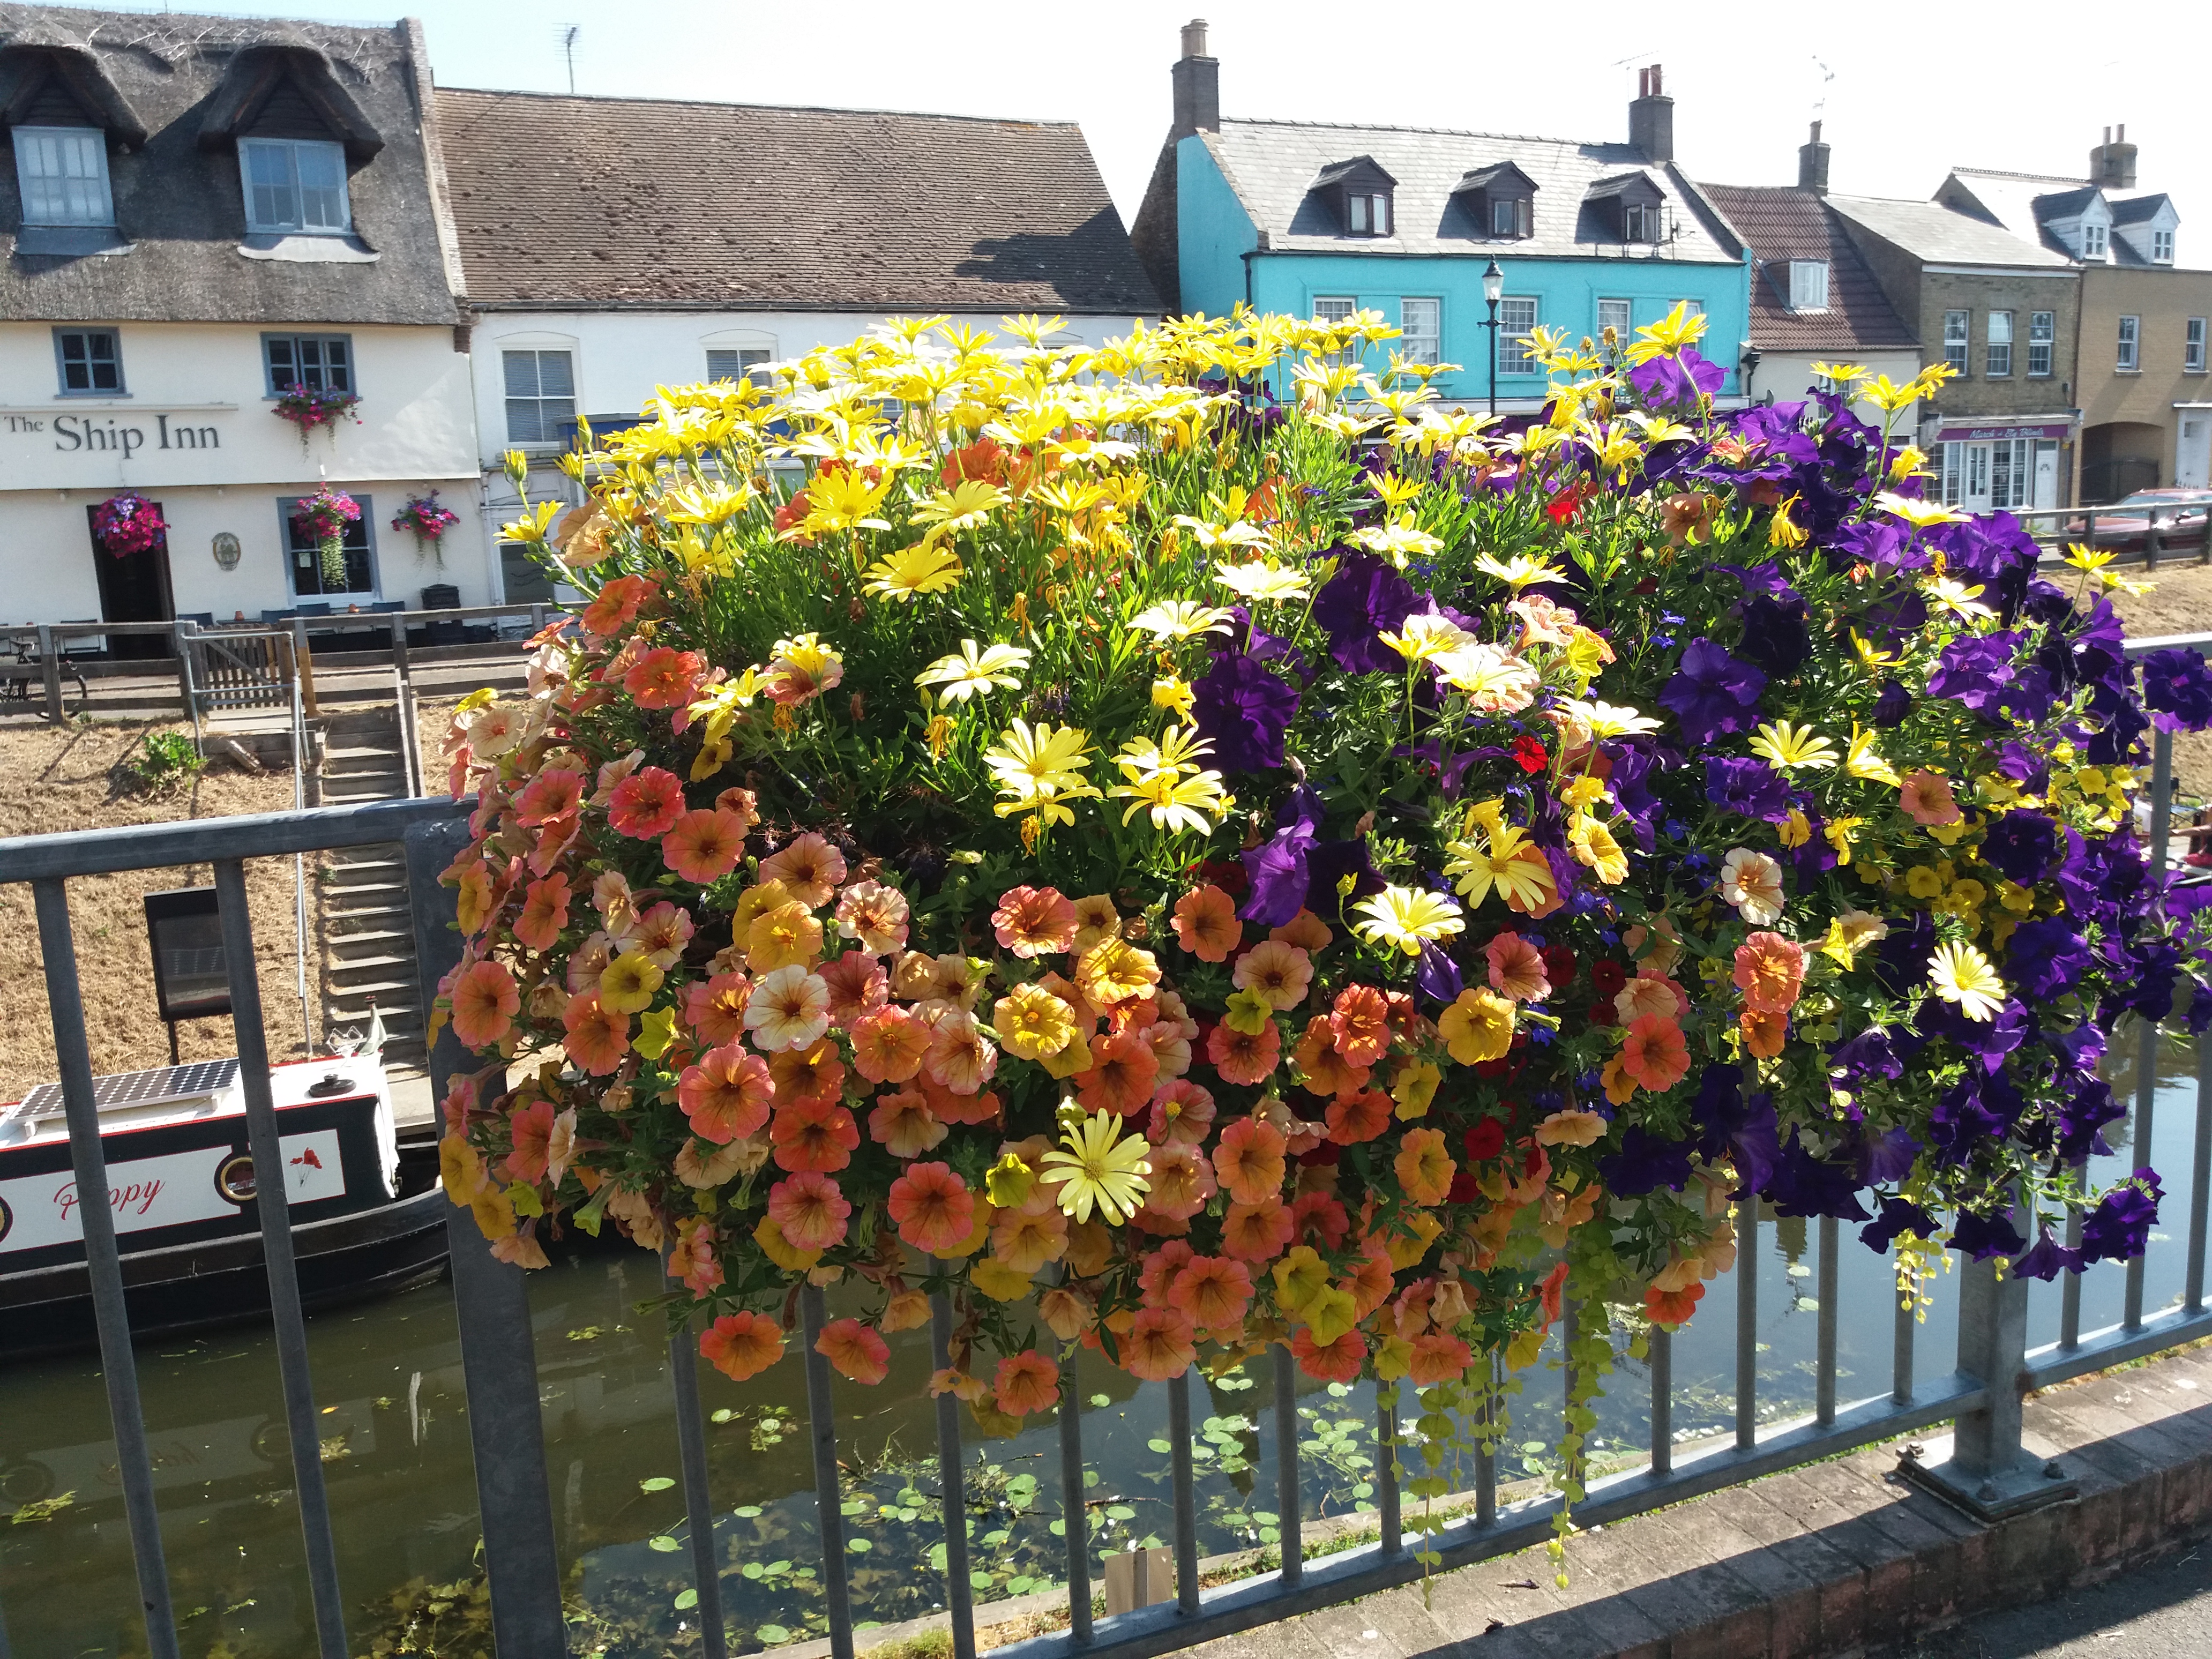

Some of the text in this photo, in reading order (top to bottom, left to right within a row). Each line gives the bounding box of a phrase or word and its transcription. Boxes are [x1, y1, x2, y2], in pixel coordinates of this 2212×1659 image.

[4, 414, 221, 459] The Ship Inn
[53, 1179, 166, 1221] Pppy
